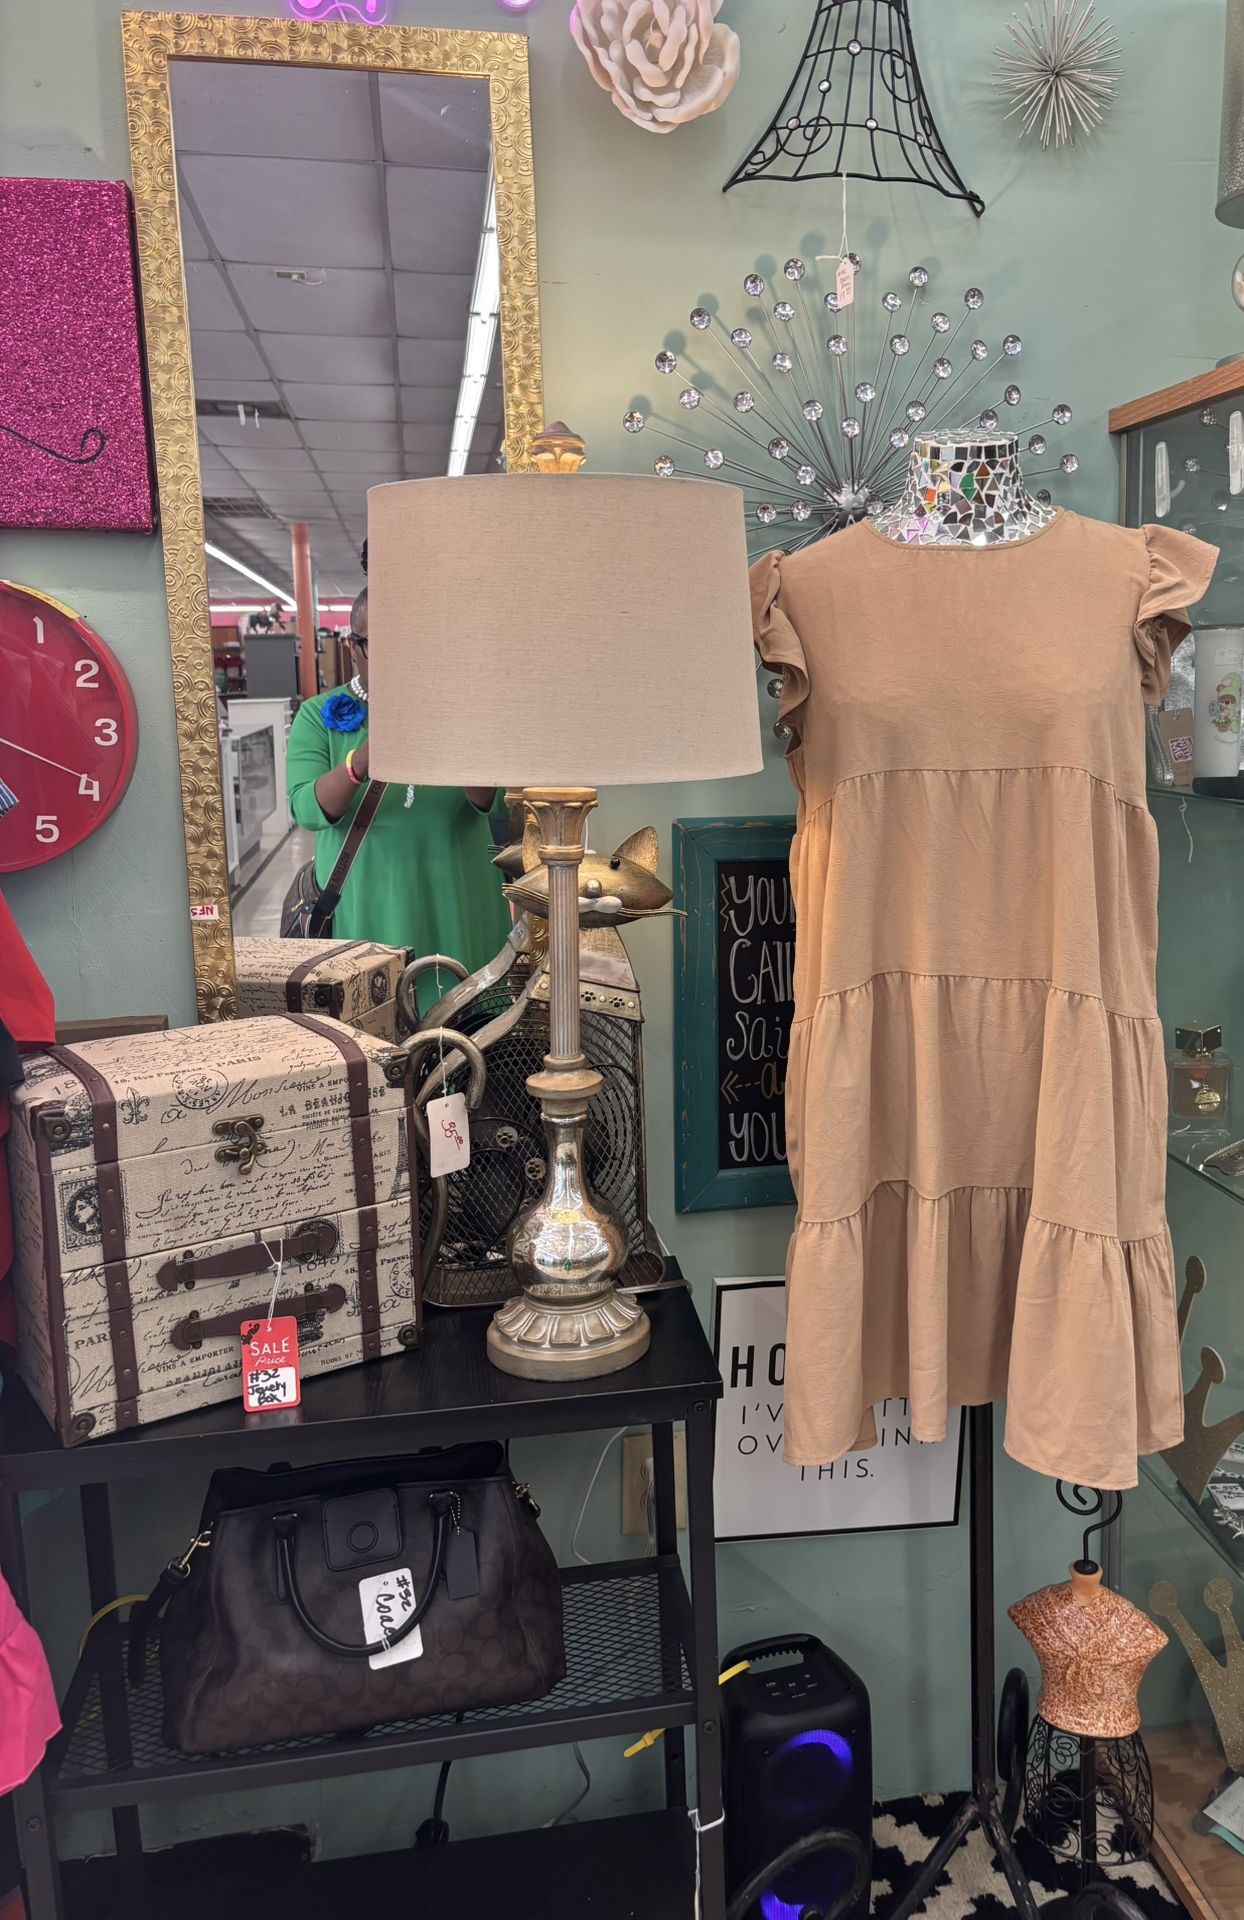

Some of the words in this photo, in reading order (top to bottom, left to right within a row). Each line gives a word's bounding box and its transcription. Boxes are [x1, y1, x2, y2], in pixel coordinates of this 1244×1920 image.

[33, 616, 44, 643] 1
[75, 660, 99, 688] 2
[94, 719, 118, 746] 3
[78, 774, 99, 801] 4
[35, 816, 59, 842] 5
[191, 905, 214, 917] NFS
[729, 875, 795, 936] YOU
[726, 1011, 788, 1060] Sai
[74, 1332, 111, 1350] PAR
[250, 1336, 290, 1356] SALE
[189, 1346, 235, 1364] EMPORTER
[249, 1368, 280, 1384] #32
[742, 1403, 784, 1425] I'V
[395, 1575, 412, 1612] #32
[376, 1593, 398, 1638] Coac
